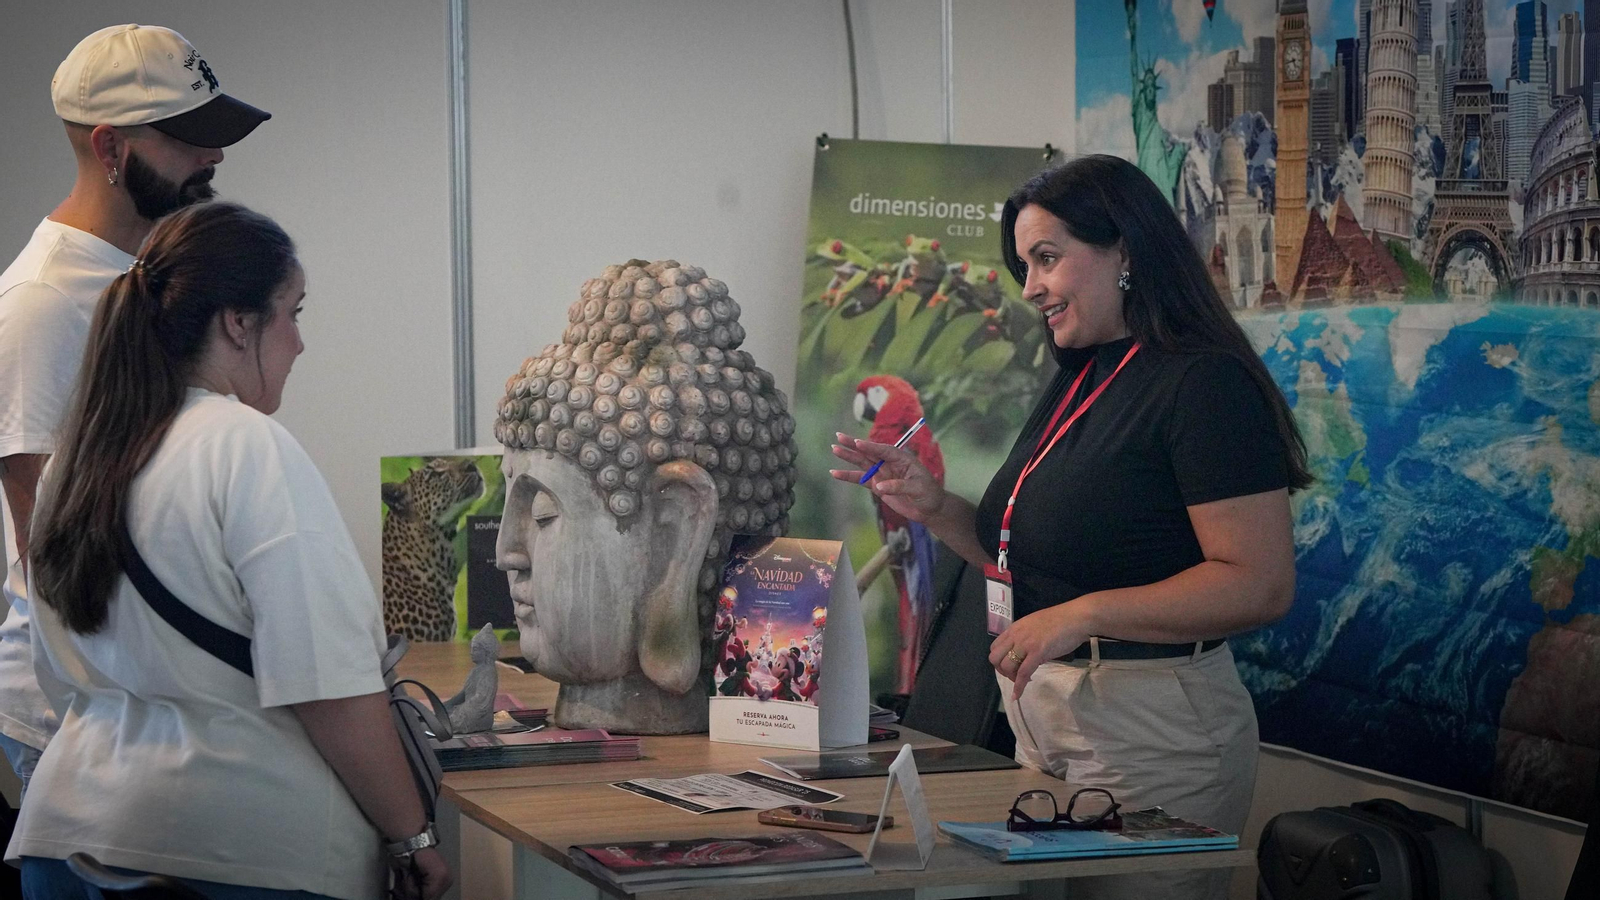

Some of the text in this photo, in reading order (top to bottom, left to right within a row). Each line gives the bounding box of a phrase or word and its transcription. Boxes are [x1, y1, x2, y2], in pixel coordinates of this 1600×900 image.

[191, 80, 205, 91] EST.
[850, 193, 986, 220] dimensiones
[947, 225, 984, 237] CLUB
[753, 567, 803, 583] NAVIDAD
[757, 581, 796, 591] ENCANTADA
[743, 711, 767, 719] RESERVA
[745, 719, 772, 728] ESCAPADA
